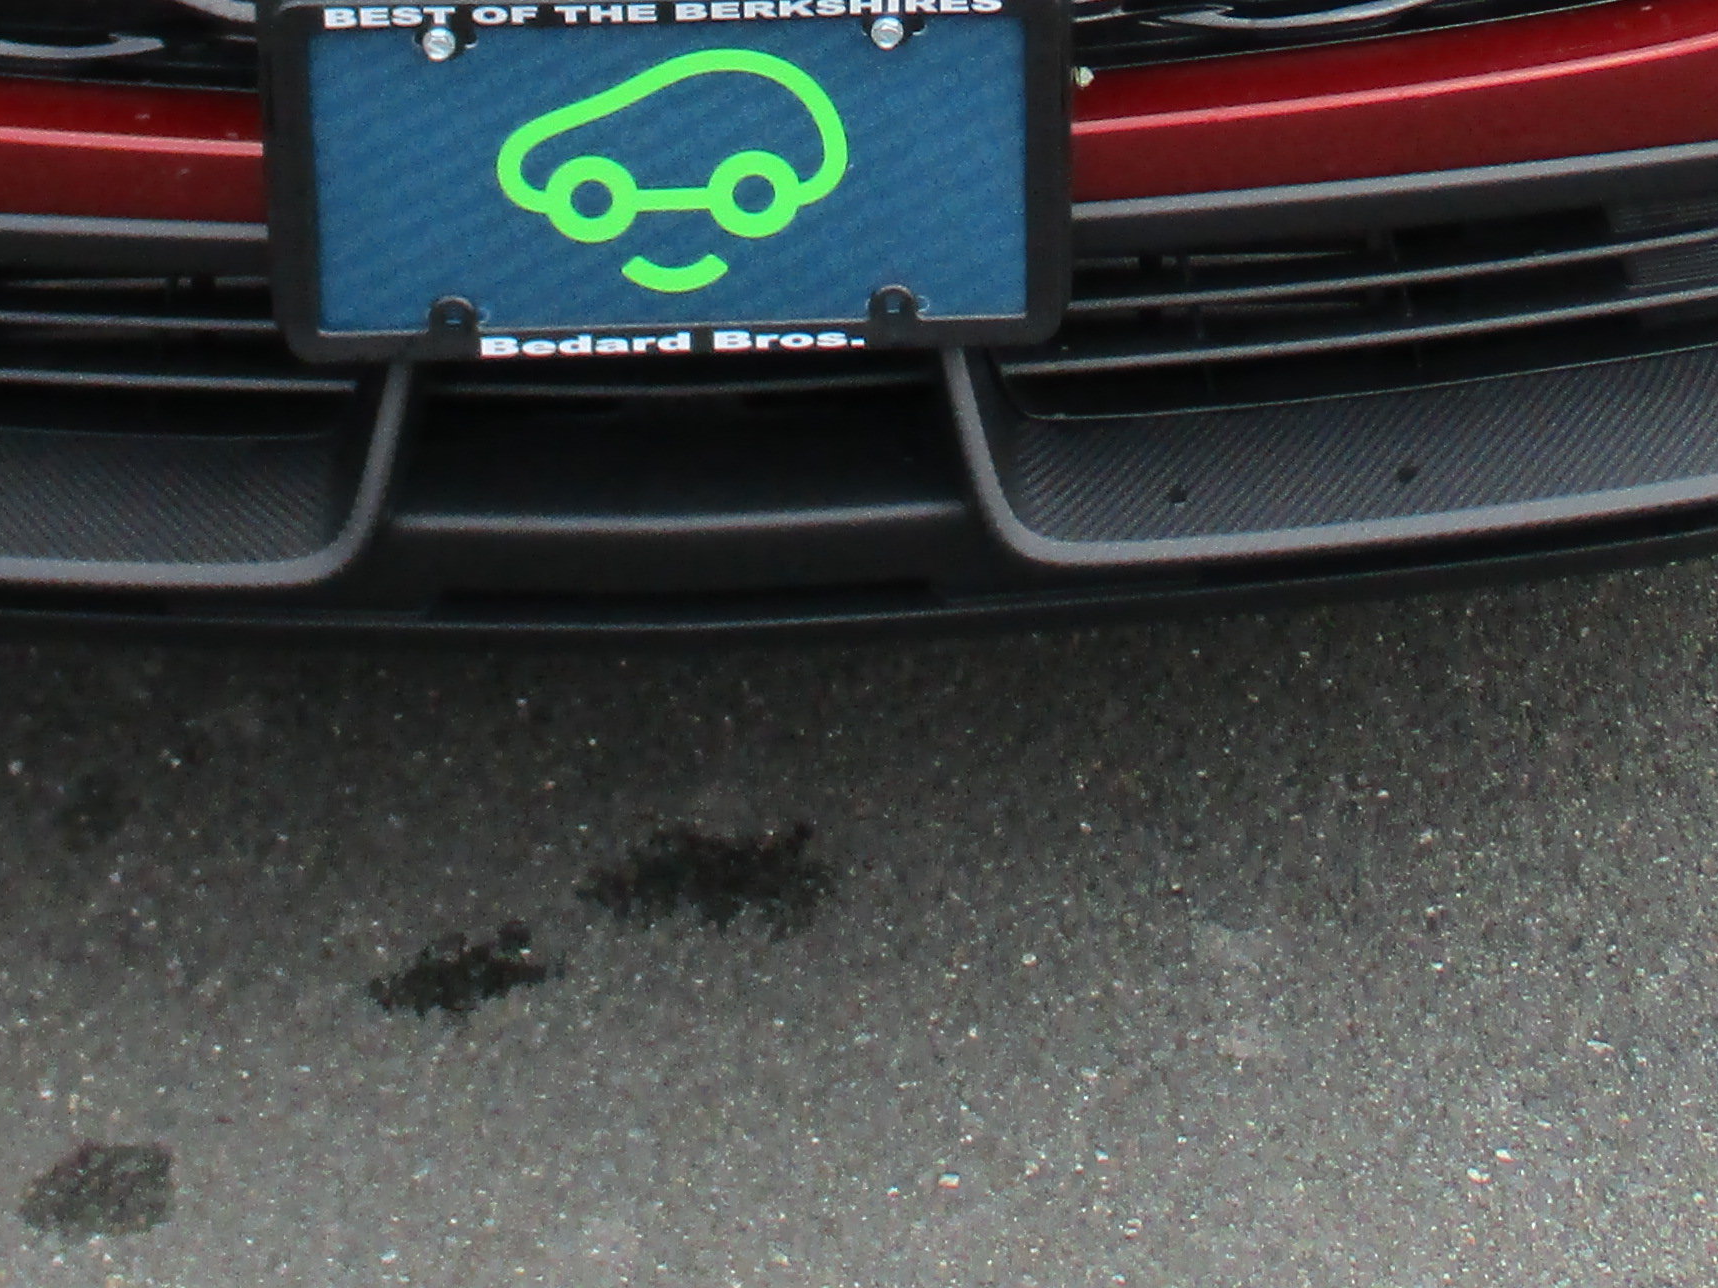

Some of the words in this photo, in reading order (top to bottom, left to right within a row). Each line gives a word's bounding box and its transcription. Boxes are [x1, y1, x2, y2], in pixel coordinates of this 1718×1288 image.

[323, 6, 456, 30] BEST
[471, 5, 538, 25] OF
[553, 3, 658, 24] THE
[480, 331, 692, 358] Bedard
[713, 329, 866, 352] Bros.
